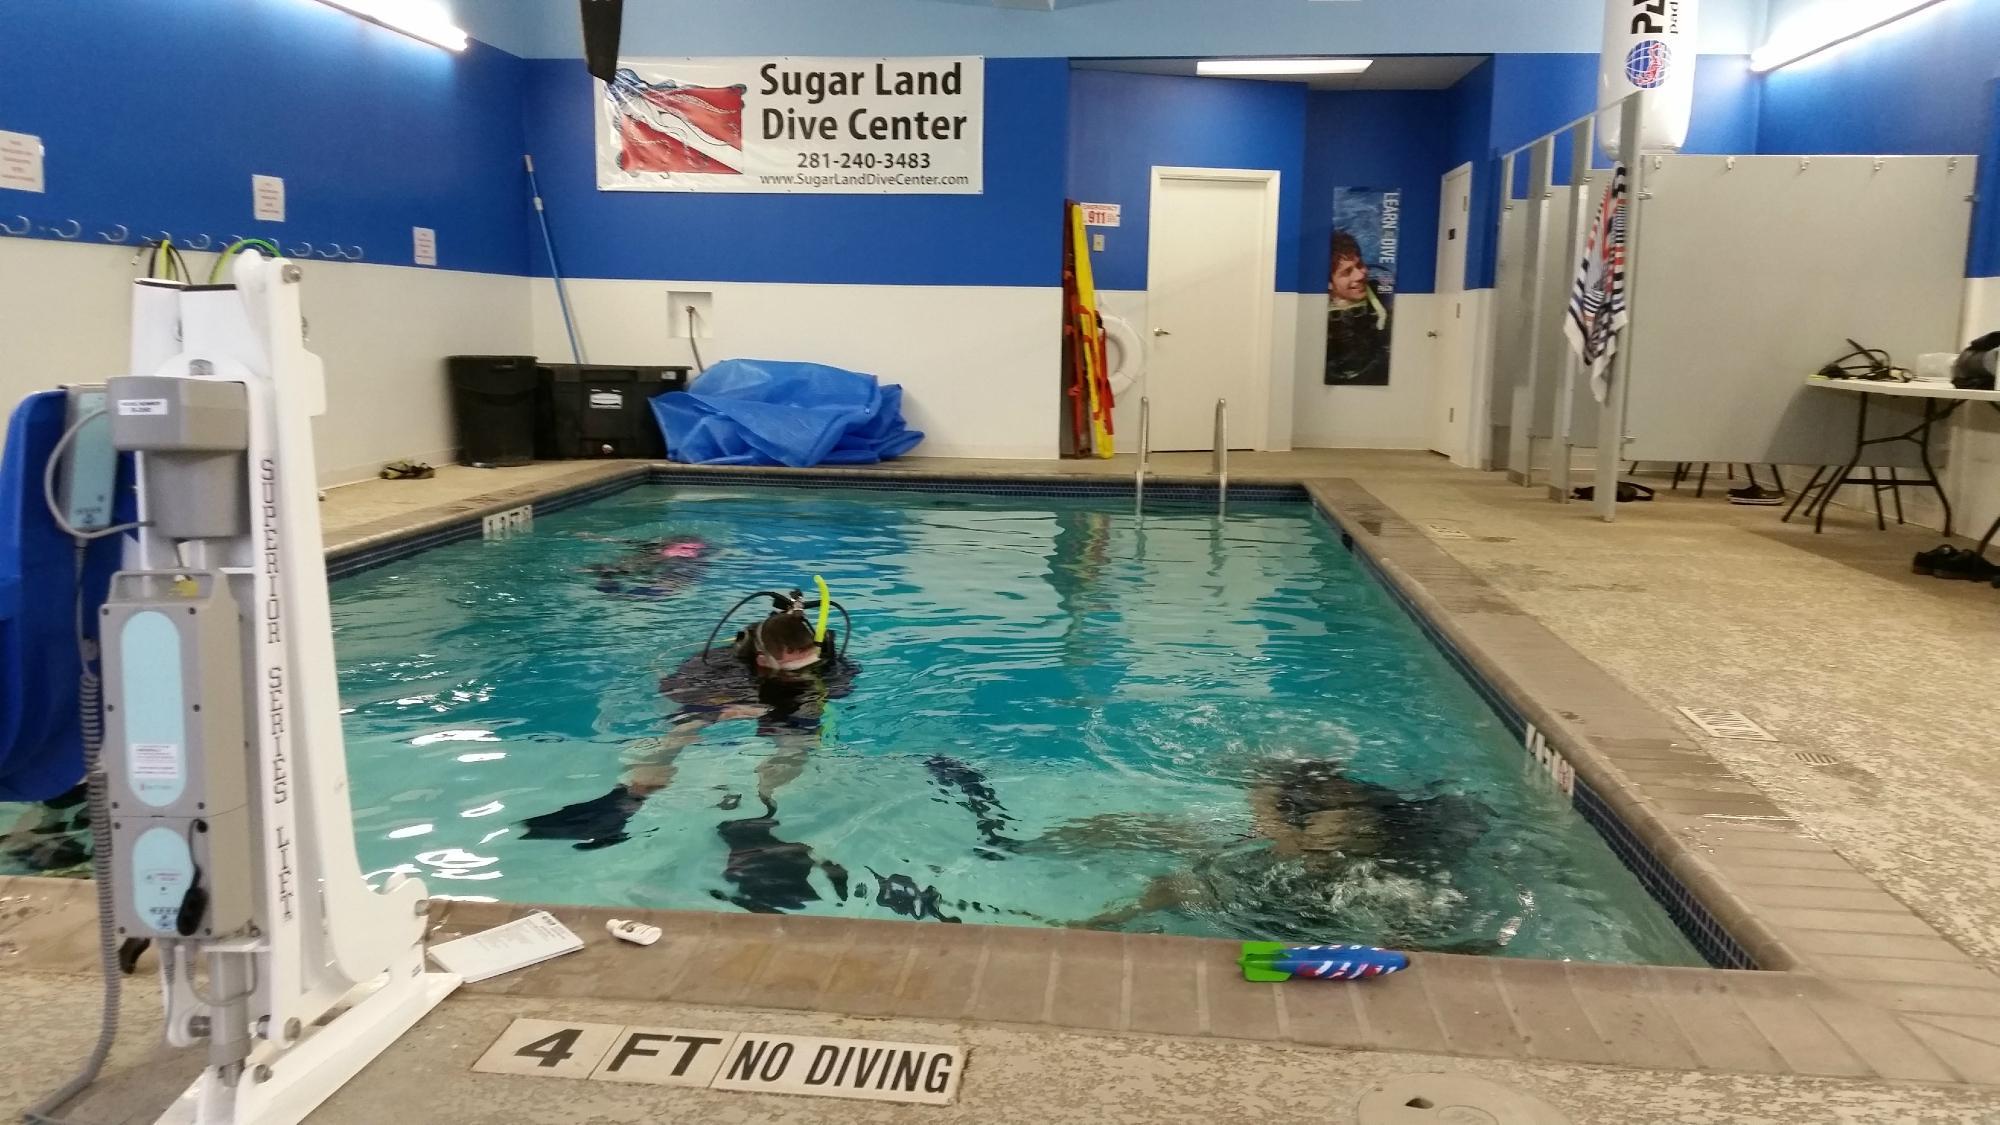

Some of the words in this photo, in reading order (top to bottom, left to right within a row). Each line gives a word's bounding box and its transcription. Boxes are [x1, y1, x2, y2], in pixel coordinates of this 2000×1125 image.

[760, 62, 864, 104] Sugar
[876, 61, 962, 96] Land
[762, 107, 838, 140] Dive
[848, 107, 967, 140] Center
[797, 152, 931, 169] 281-240-3483
[760, 173, 969, 187] www.SugarLandDiveCenter.com
[1088, 210, 1106, 224] 911
[1381, 192, 1399, 229] LEARN
[1379, 238, 1397, 264] DIVE
[261, 458, 281, 644] SUPERIOR
[268, 666, 287, 804] SERIES
[514, 1028, 584, 1068] 4
[606, 1033, 722, 1077] FT
[726, 1039, 795, 1083] NO
[804, 1045, 953, 1094] DIVING
